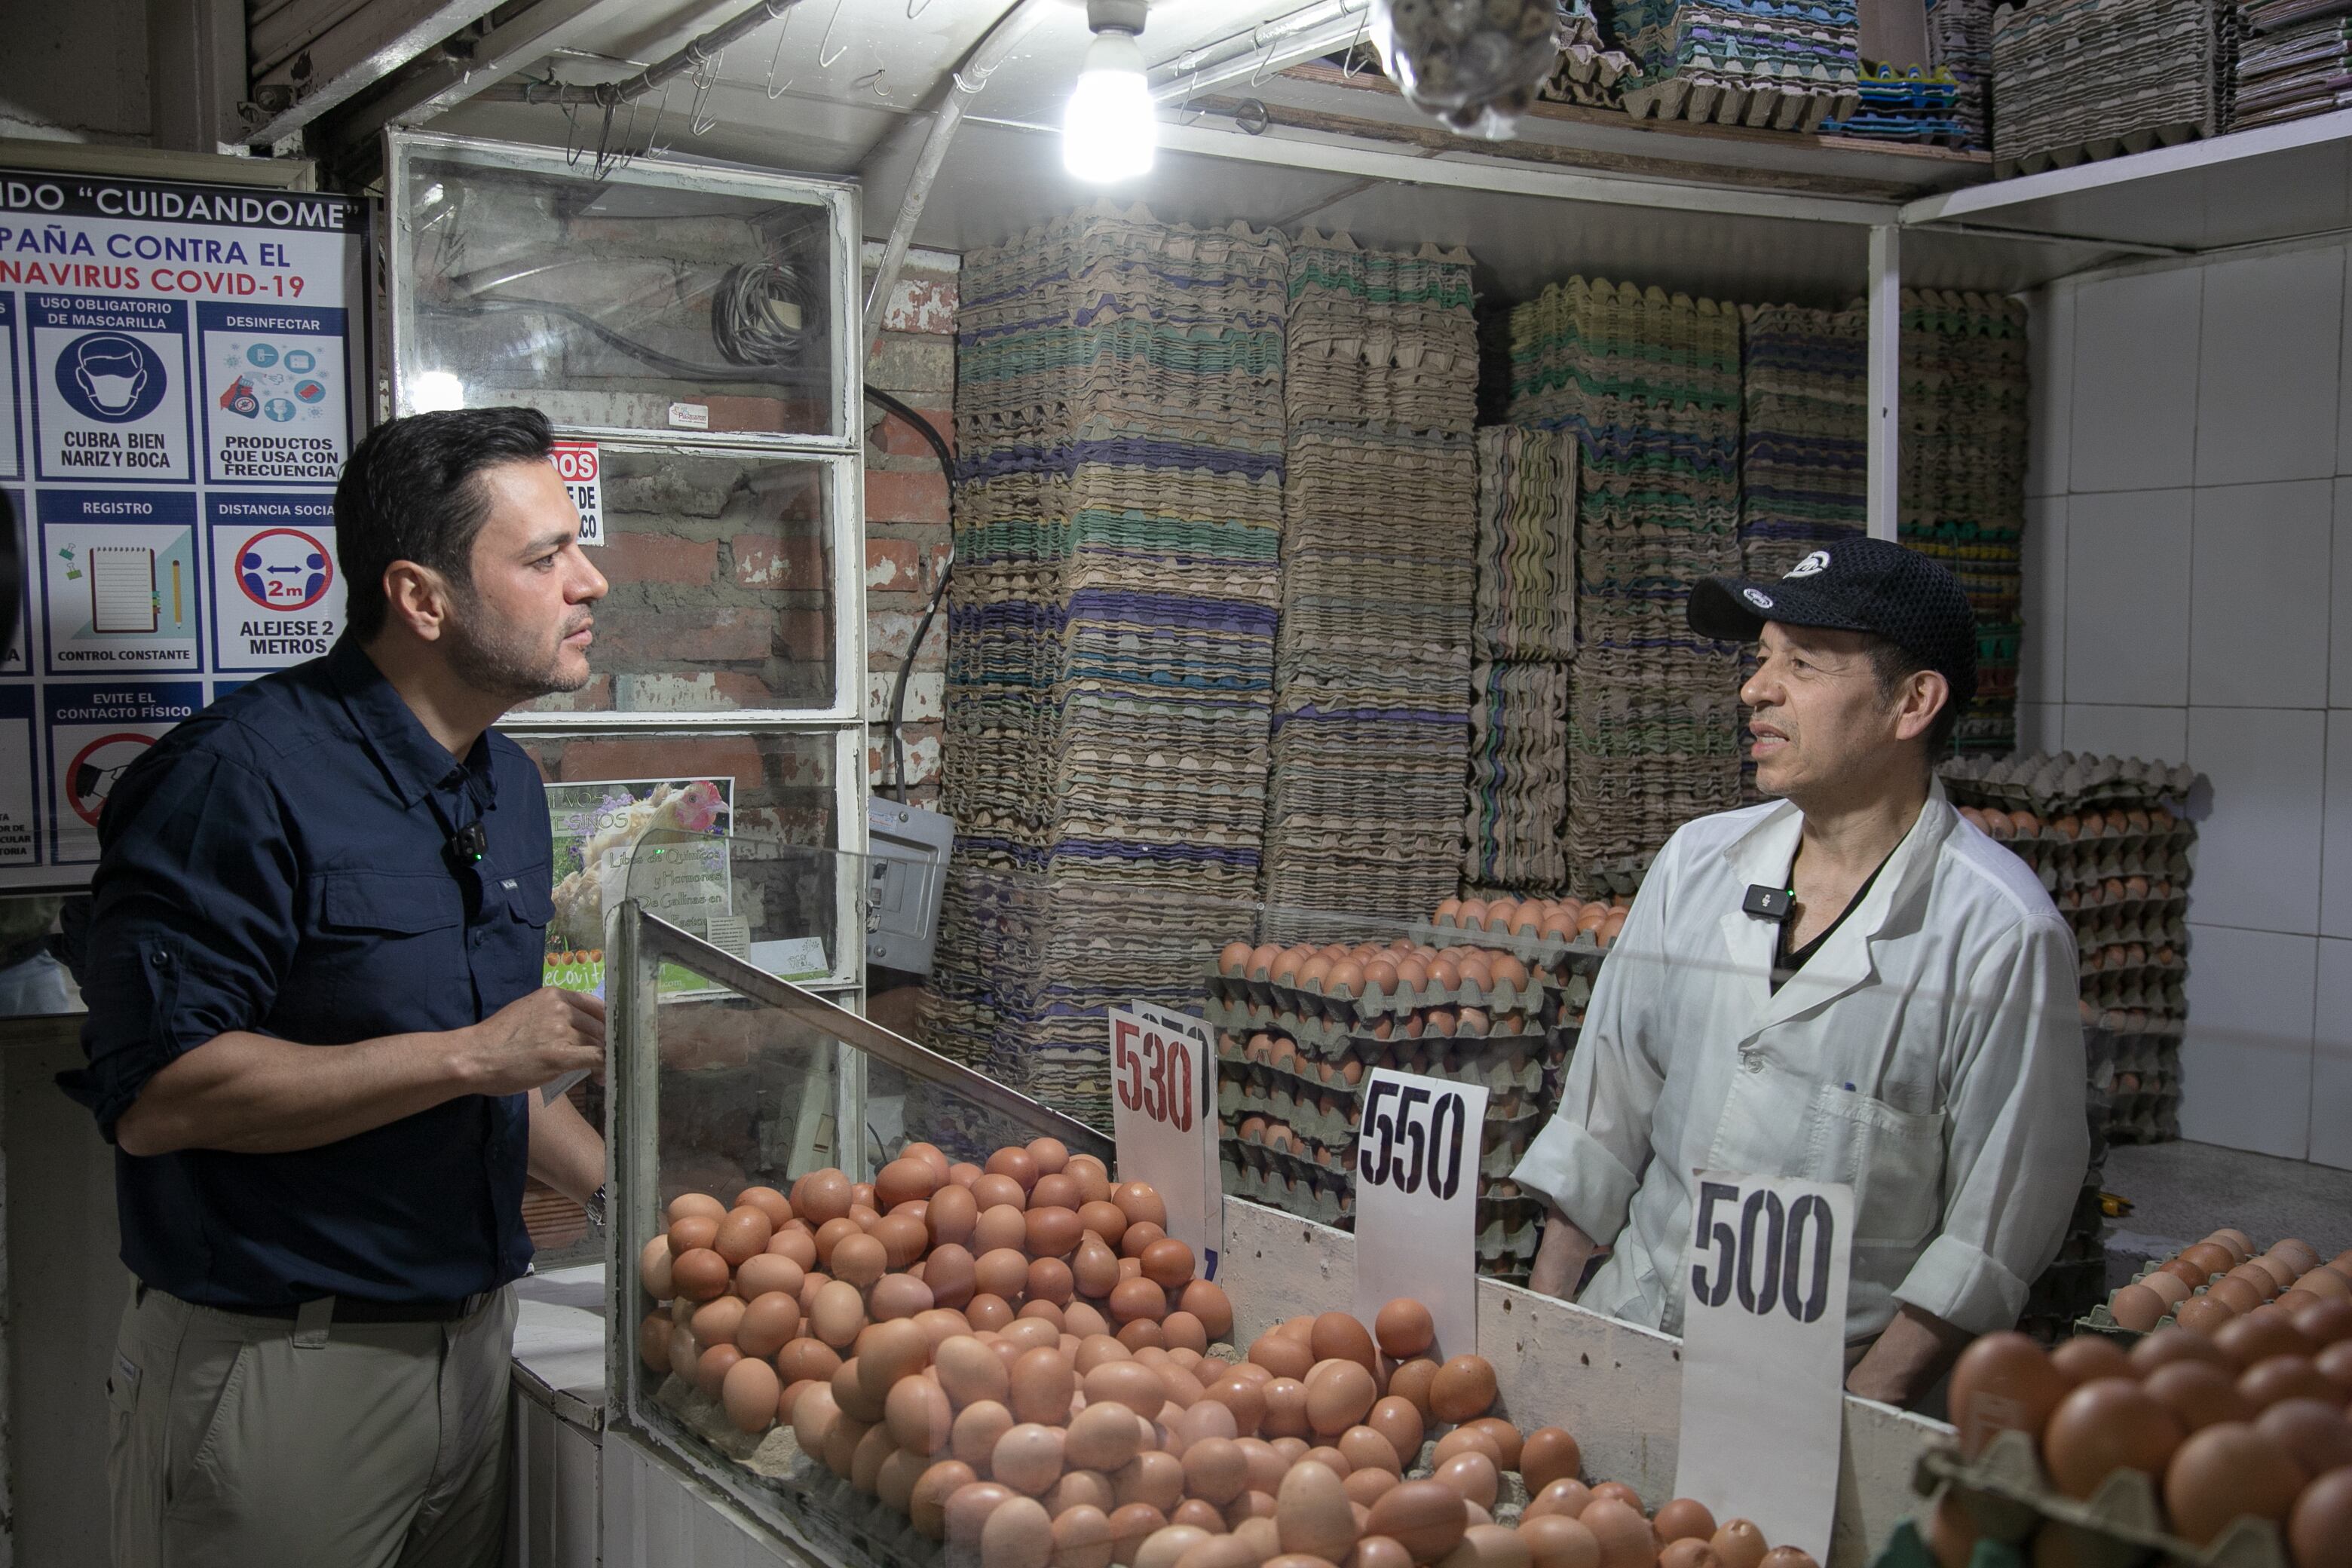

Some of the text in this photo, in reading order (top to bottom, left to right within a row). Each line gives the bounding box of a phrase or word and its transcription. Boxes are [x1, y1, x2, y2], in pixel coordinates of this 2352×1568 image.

[107, 233, 248, 265] CONTRA
[259, 243, 291, 268] EL
[151, 268, 305, 298] COVID-19
[40, 297, 172, 314] USO OBLIGATORIO
[48, 314, 167, 329] DE MASCARILLA
[226, 316, 320, 330] DESINFECTAR
[64, 431, 165, 449] CUBRA BIEN
[225, 436, 333, 450] PRODUCTOS
[61, 450, 170, 467] NARIZ Y BOCA
[220, 450, 338, 464] QUE USA CON
[225, 464, 337, 477] FRECUENCIA
[578, 485, 596, 509] DE
[83, 502, 152, 514] REGISTRO
[219, 504, 291, 516] DISTANCIA
[268, 580, 303, 596] 2 m
[240, 620, 334, 636] ALEJESE 2
[250, 639, 327, 654] METROS
[57, 650, 191, 661] CONTROL CONSTANTE
[93, 693, 156, 704] EVITE EL
[57, 705, 192, 719] CONTACTO FÍSICO
[1116, 1018, 1193, 1132] 530
[1360, 1080, 1465, 1201] 550
[1691, 1181, 1834, 1324] 500
